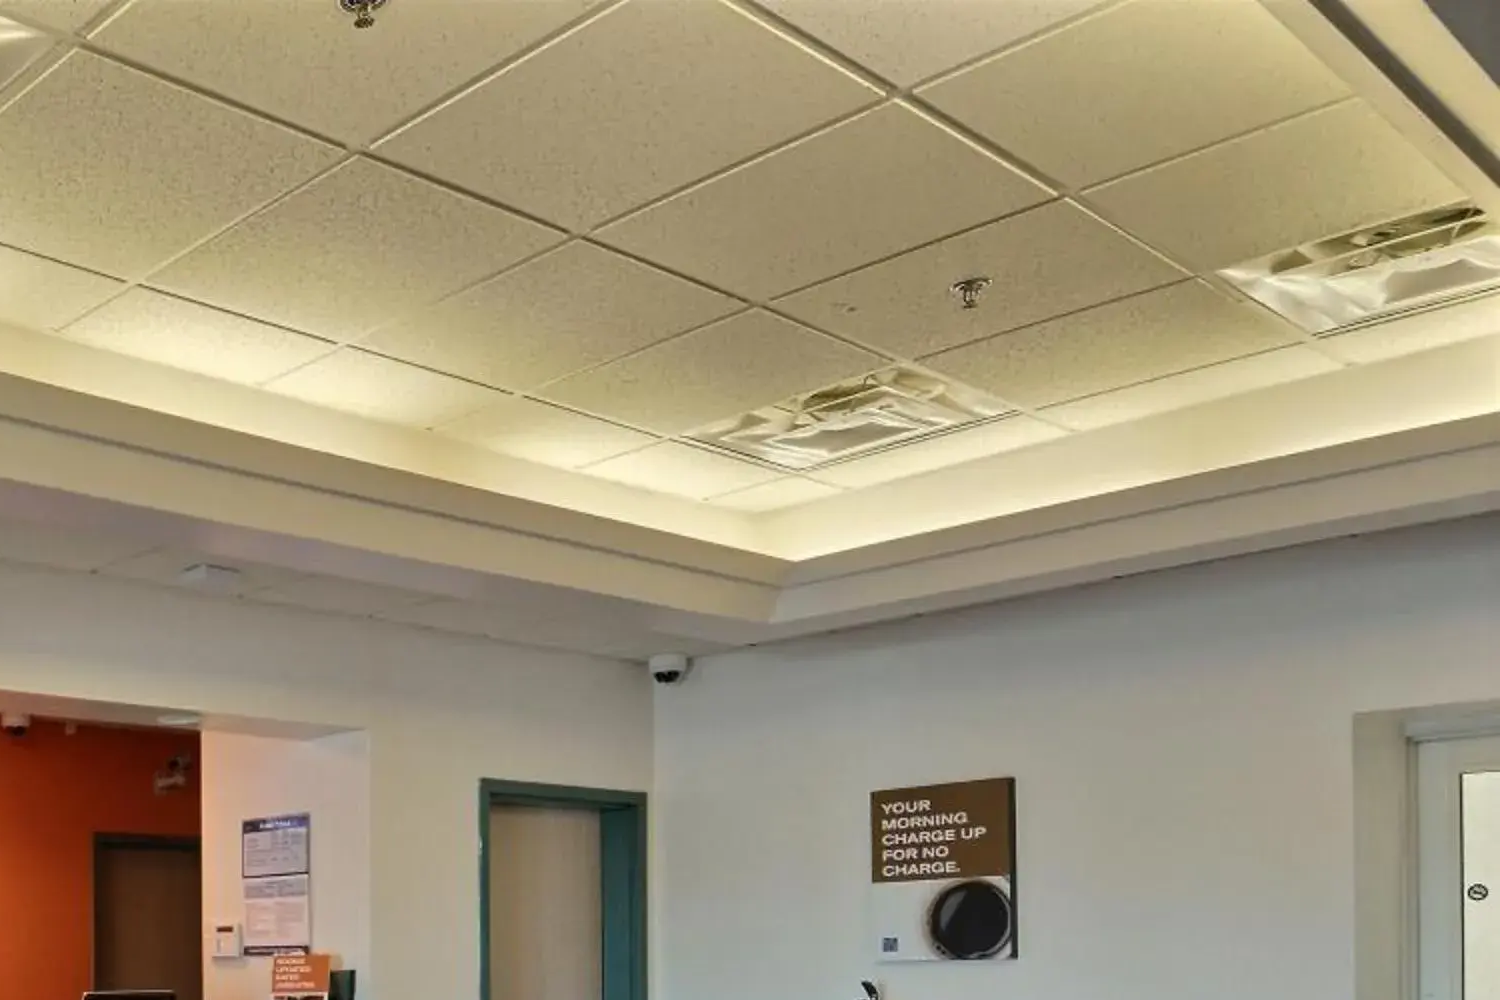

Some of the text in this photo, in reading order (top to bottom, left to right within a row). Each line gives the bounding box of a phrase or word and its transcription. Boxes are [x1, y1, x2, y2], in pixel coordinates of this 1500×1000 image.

[881, 799, 931, 815] YOUR
[881, 811, 969, 831] MORNING
[882, 826, 987, 847] CHARGE UP
[882, 845, 949, 862] FOR NO
[882, 861, 961, 877] CHARGE.
